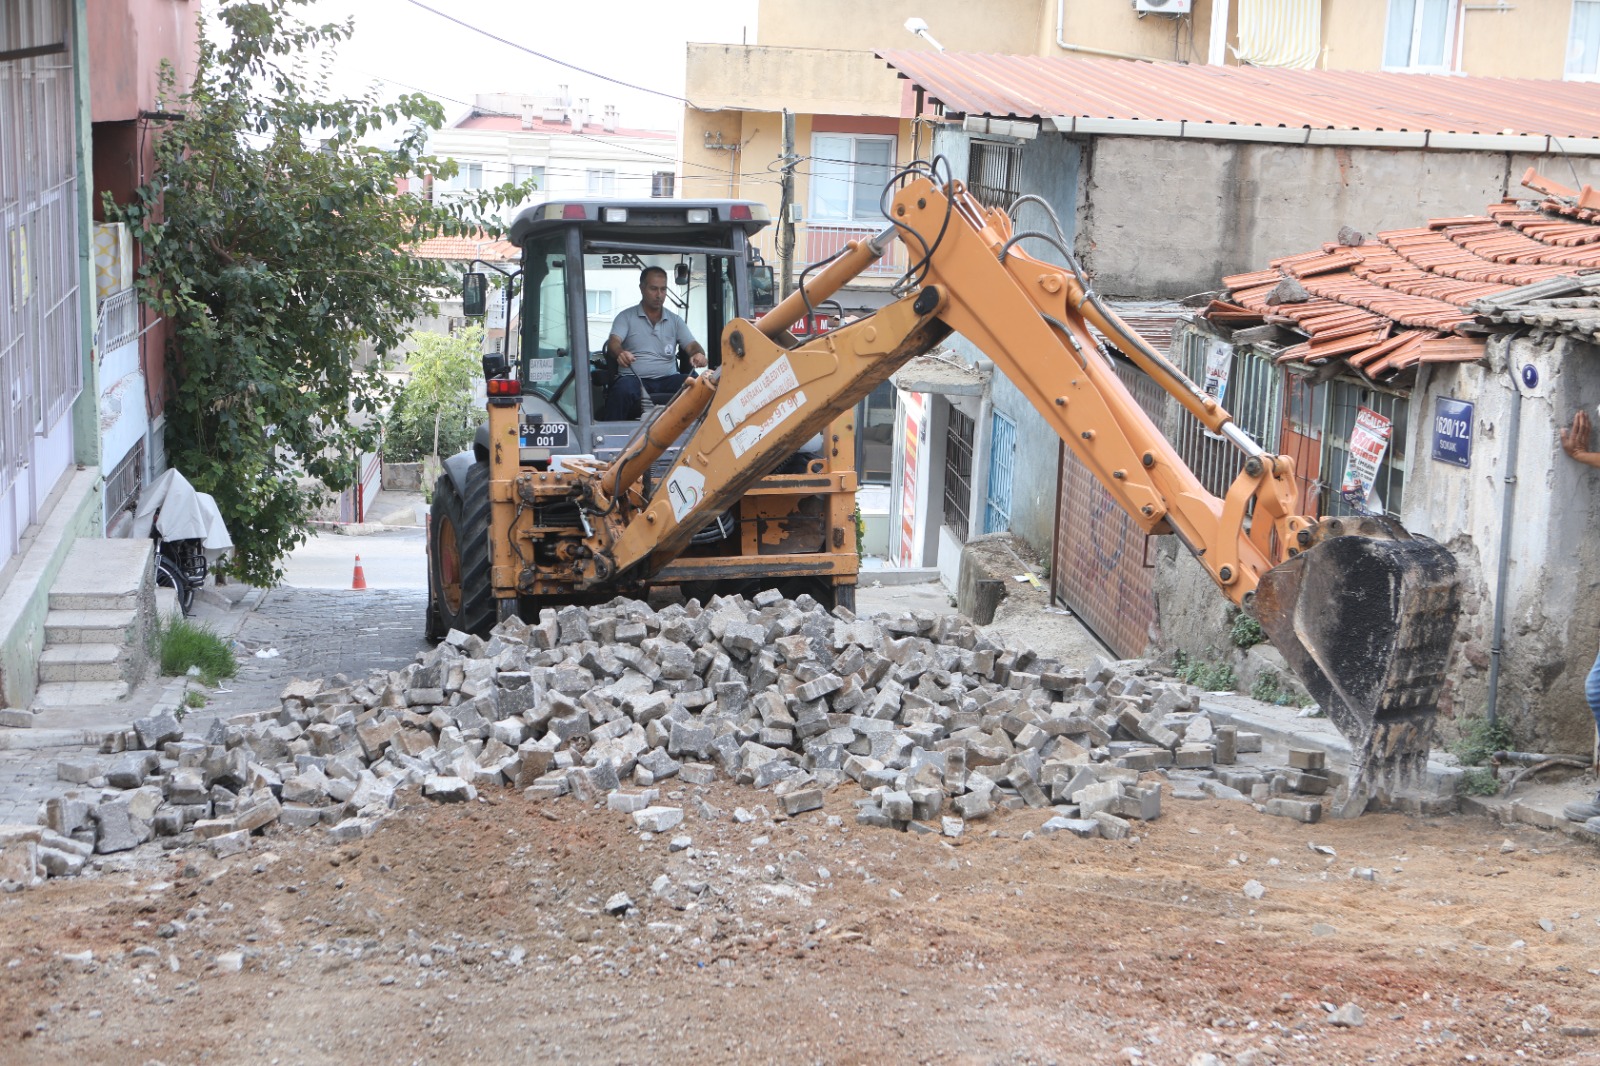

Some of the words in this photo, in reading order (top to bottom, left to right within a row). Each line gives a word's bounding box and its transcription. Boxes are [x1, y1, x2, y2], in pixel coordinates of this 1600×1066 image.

[1526, 369, 1532, 380] 9
[522, 424, 535, 434] 35
[540, 424, 565, 434] 2009
[536, 437, 554, 446] 001
[1439, 439, 1457, 453] SOKAK
